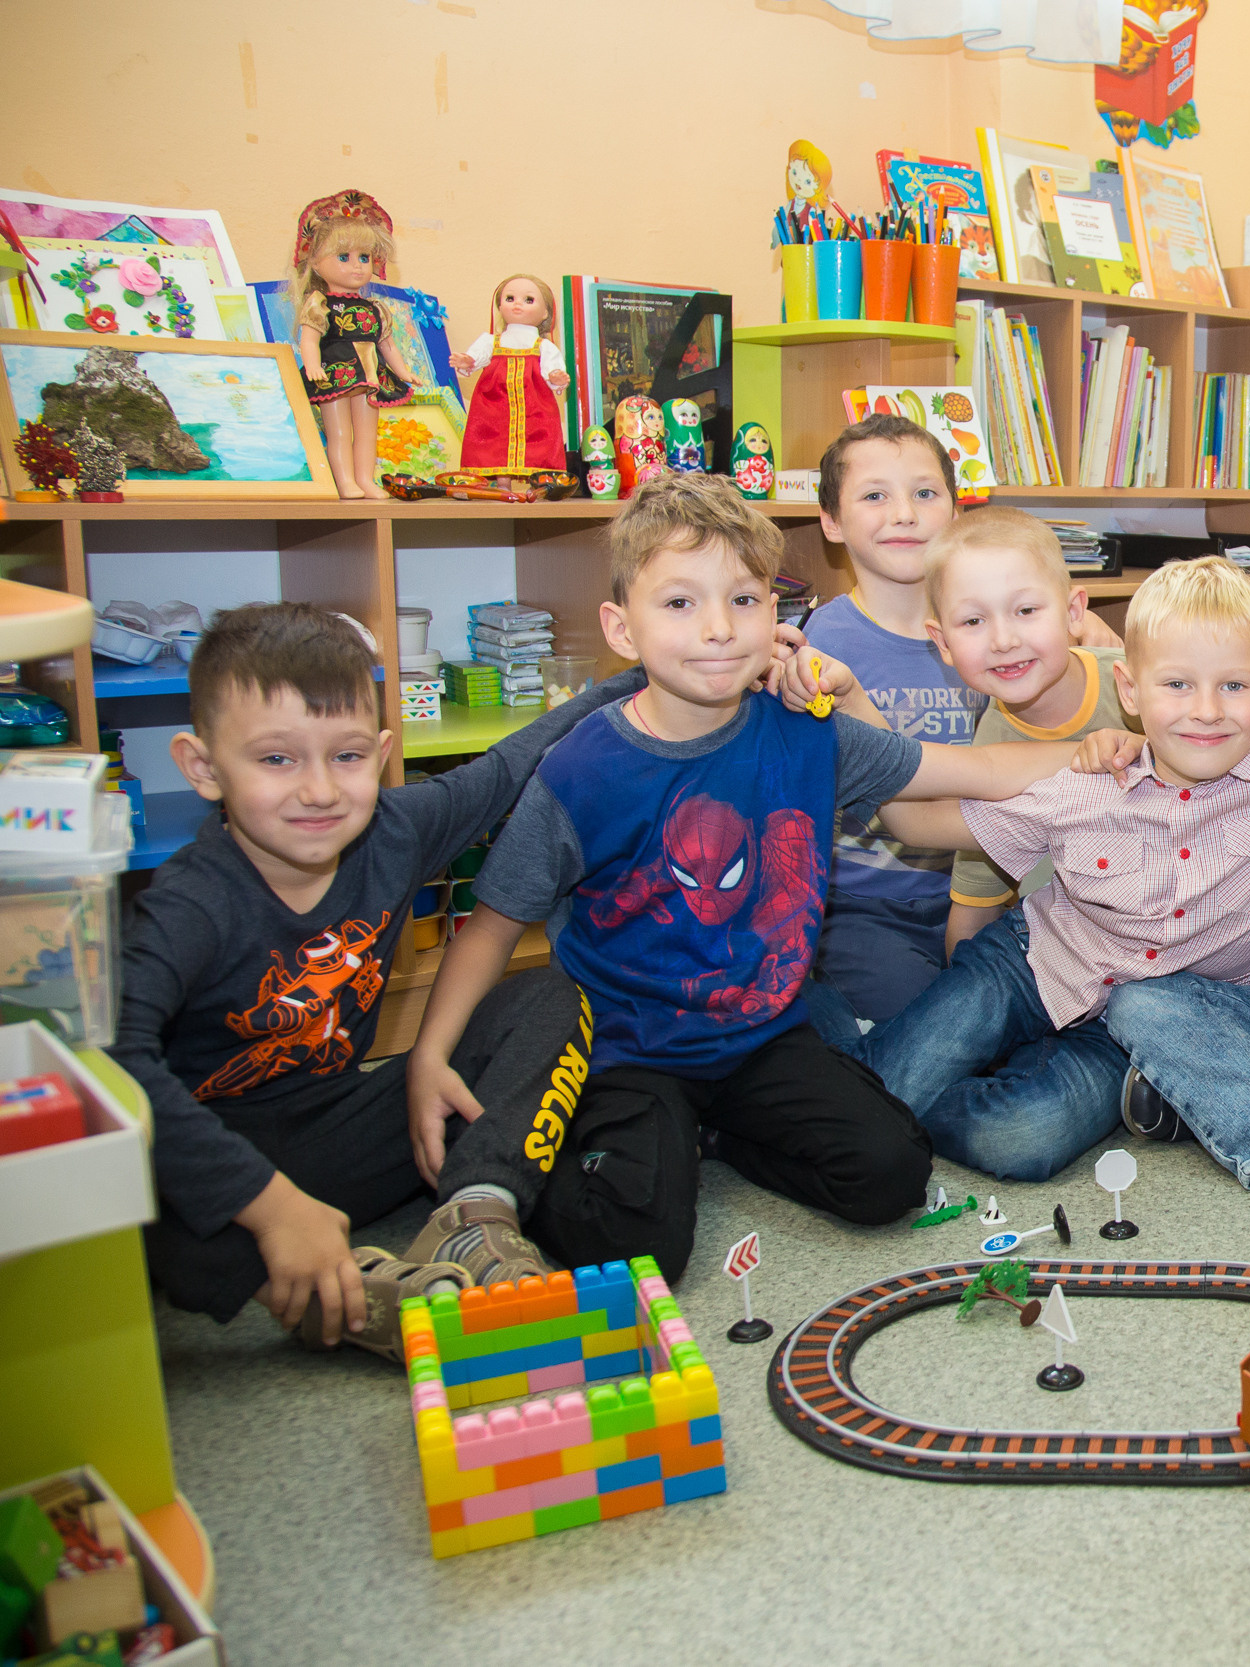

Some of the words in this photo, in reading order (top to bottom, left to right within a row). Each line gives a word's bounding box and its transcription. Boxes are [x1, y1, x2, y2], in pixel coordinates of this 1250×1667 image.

[1171, 34, 1193, 59] ХОЧУ
[620, 304, 656, 314] искусства»
[902, 687, 963, 709] YORK
[923, 711, 976, 735] STY
[524, 1042, 589, 1173] RULES
